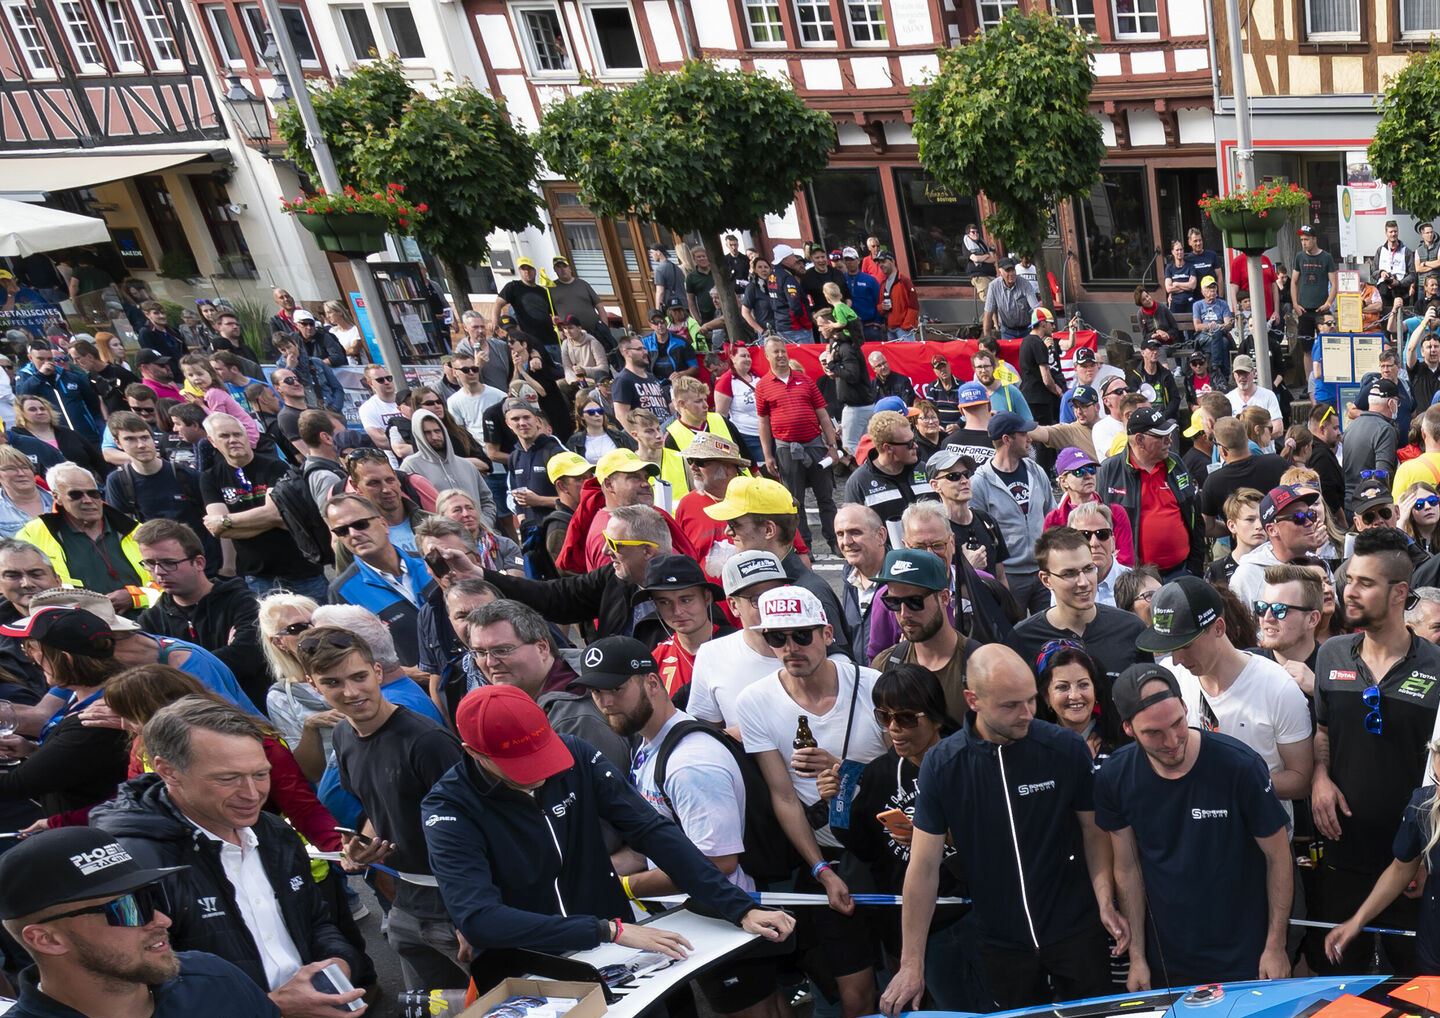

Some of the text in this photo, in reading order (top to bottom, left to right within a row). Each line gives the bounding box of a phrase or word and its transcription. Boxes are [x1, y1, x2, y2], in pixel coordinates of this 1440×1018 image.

[1276, 492, 1290, 504] 33
[765, 600, 799, 614] NBR
[1419, 672, 1437, 680] TOTAL
